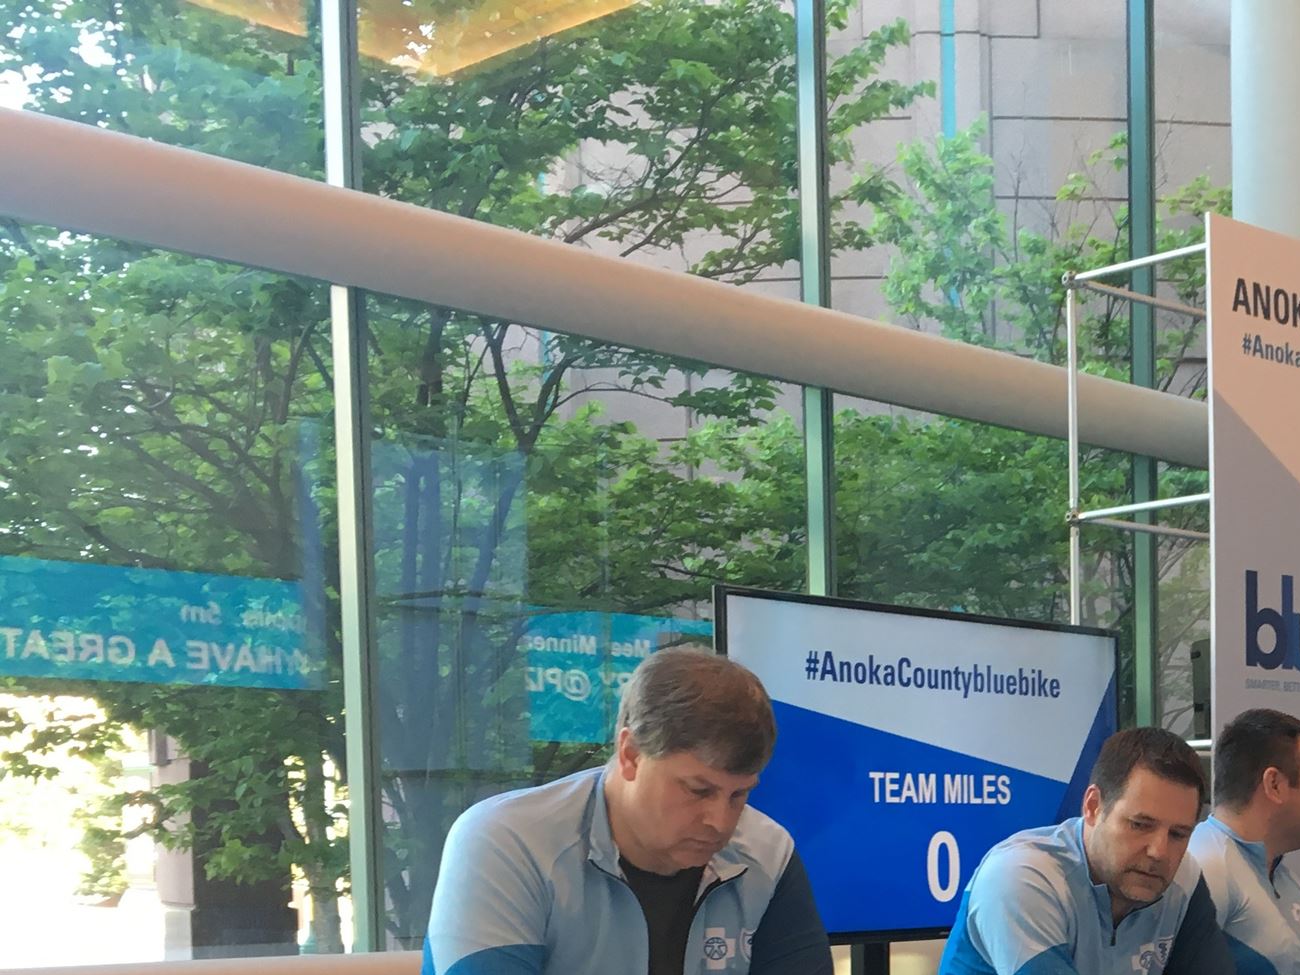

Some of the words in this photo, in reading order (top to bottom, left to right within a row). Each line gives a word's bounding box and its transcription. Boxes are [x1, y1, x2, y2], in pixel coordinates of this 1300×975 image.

[805, 650, 1062, 699] #AnokaCountybluebike
[868, 771, 937, 804] TEAM
[943, 773, 1012, 805] MILES
[926, 830, 961, 903] 0
